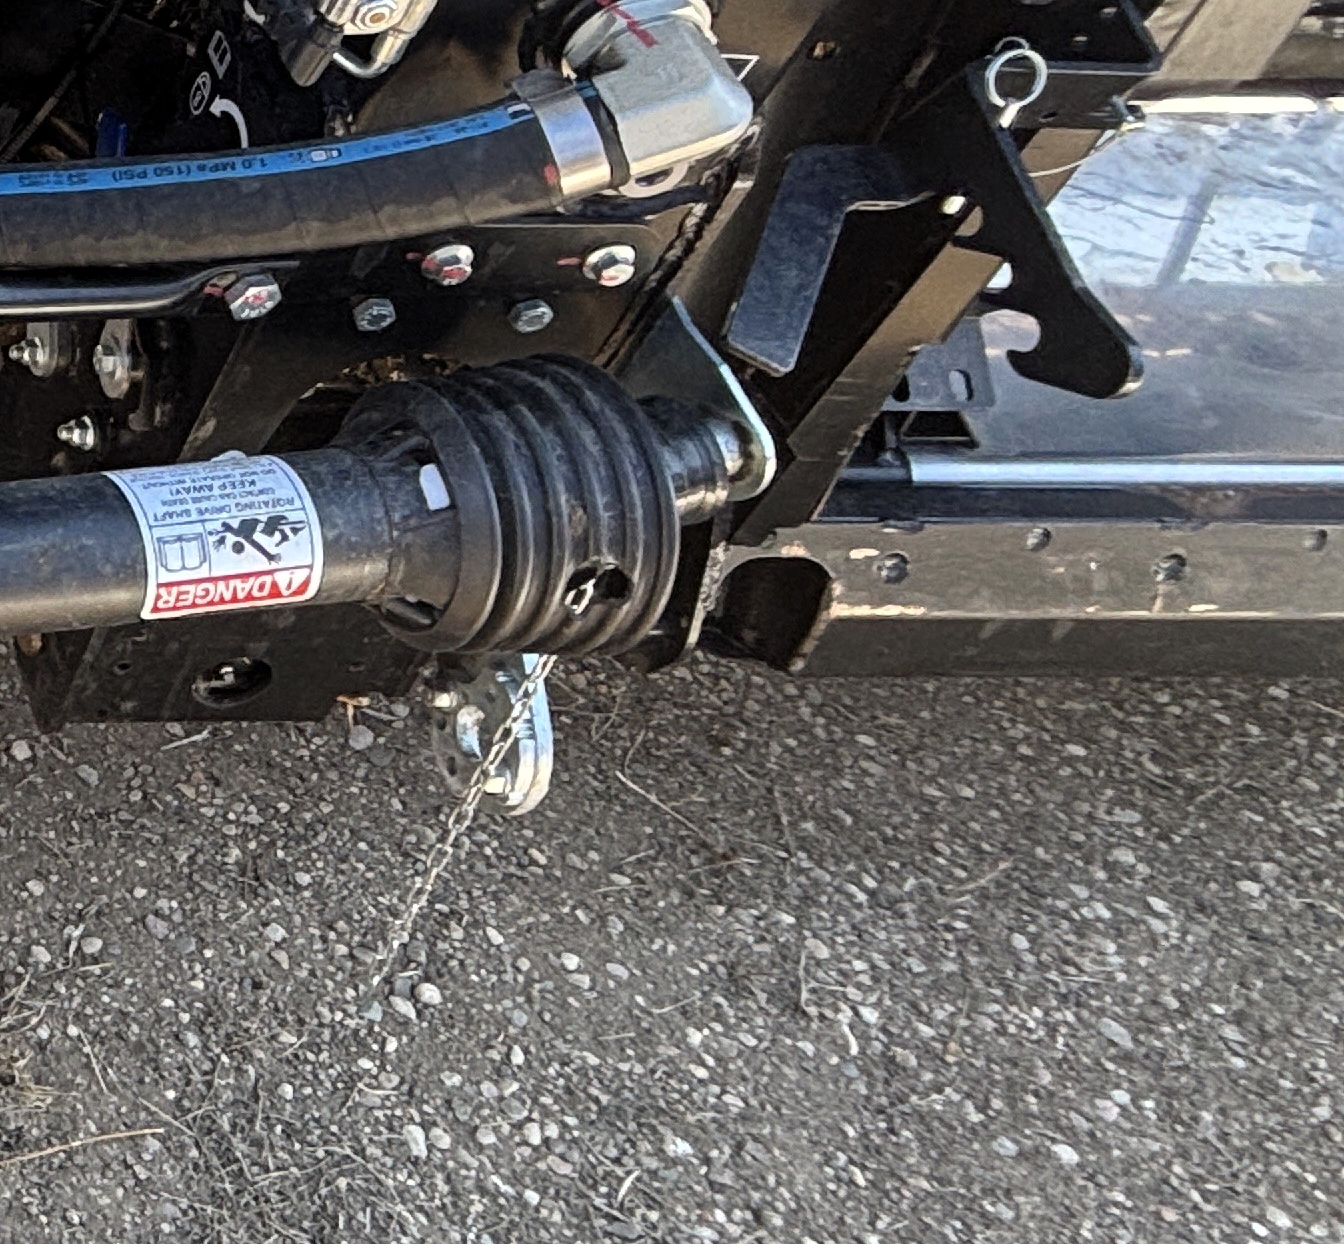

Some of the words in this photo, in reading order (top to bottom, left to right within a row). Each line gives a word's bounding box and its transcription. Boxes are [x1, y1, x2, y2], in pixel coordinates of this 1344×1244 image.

[153, 164, 191, 179] (150
[197, 160, 237, 173] MPa
[112, 167, 149, 183] PSI)
[217, 478, 257, 492] KEEP
[196, 505, 232, 517] DRIVE
[234, 496, 296, 512] ROTATING
[153, 507, 193, 522] SHAFT
[156, 574, 274, 609] DANGER
